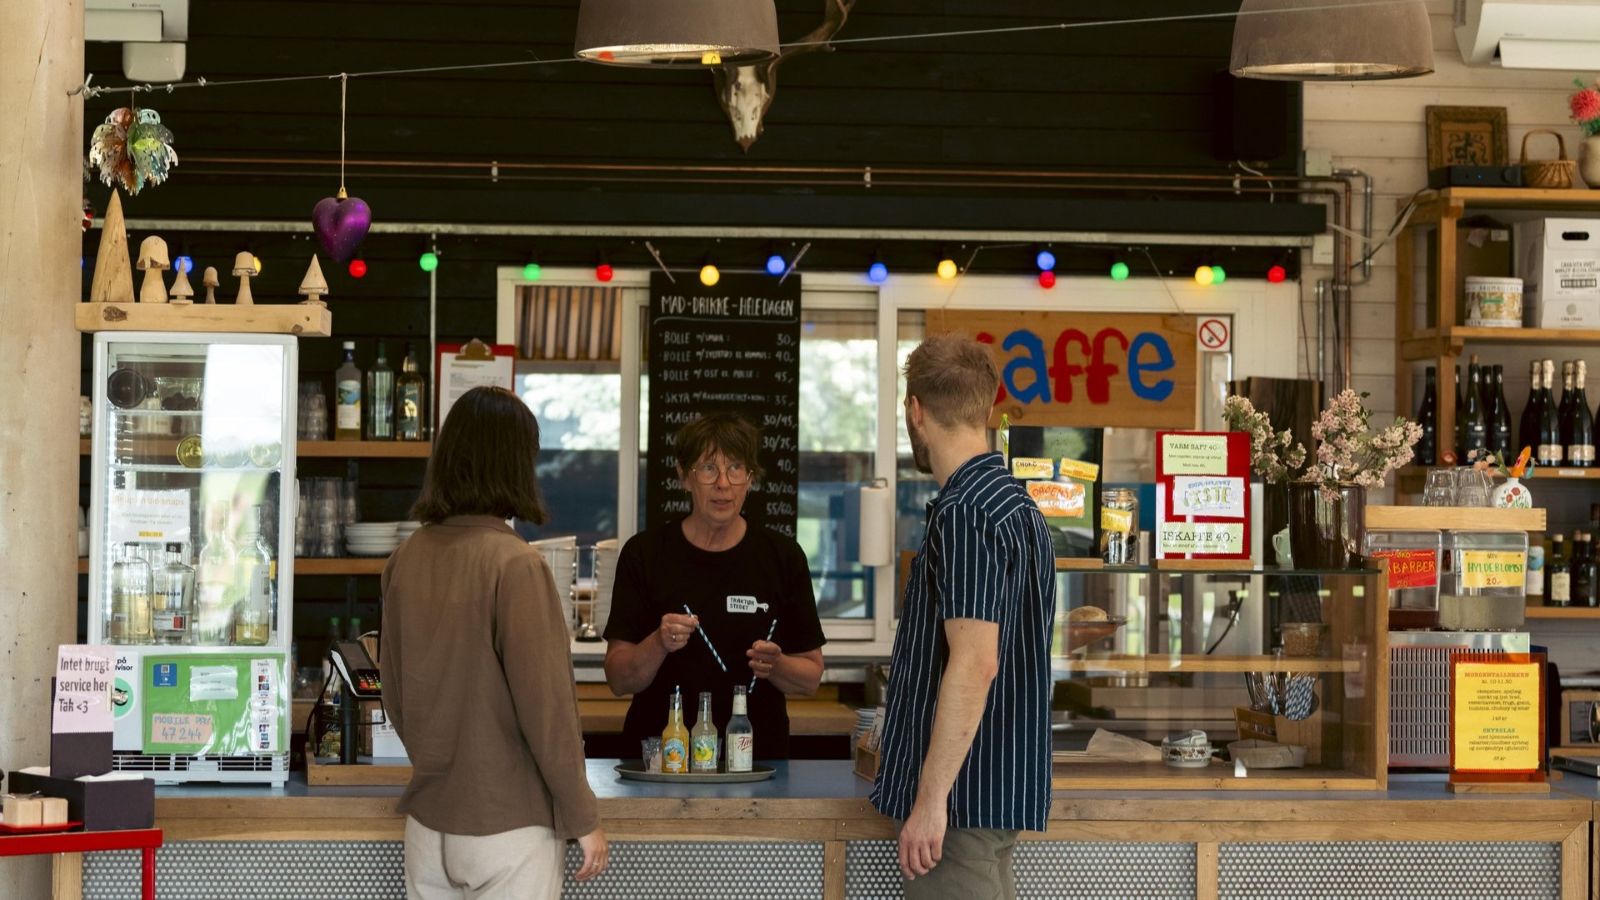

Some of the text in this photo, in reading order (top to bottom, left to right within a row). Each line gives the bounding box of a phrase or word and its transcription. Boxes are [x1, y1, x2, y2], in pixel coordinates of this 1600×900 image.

[664, 330, 691, 345] BOLLE
[663, 350, 691, 362] BOLLE
[663, 369, 689, 381] BOLLE
[665, 393, 690, 404] SKYR
[1191, 443, 1207, 452] SAFT
[1163, 531, 1213, 542] ISKAFFE
[1388, 560, 1435, 575] BARBER
[1467, 562, 1525, 574] HYLDEBLOMST
[60, 657, 110, 674] Intet brugt
[60, 677, 108, 692] service her
[59, 698, 89, 714] Tak <3
[154, 715, 190, 725] MOBILE
